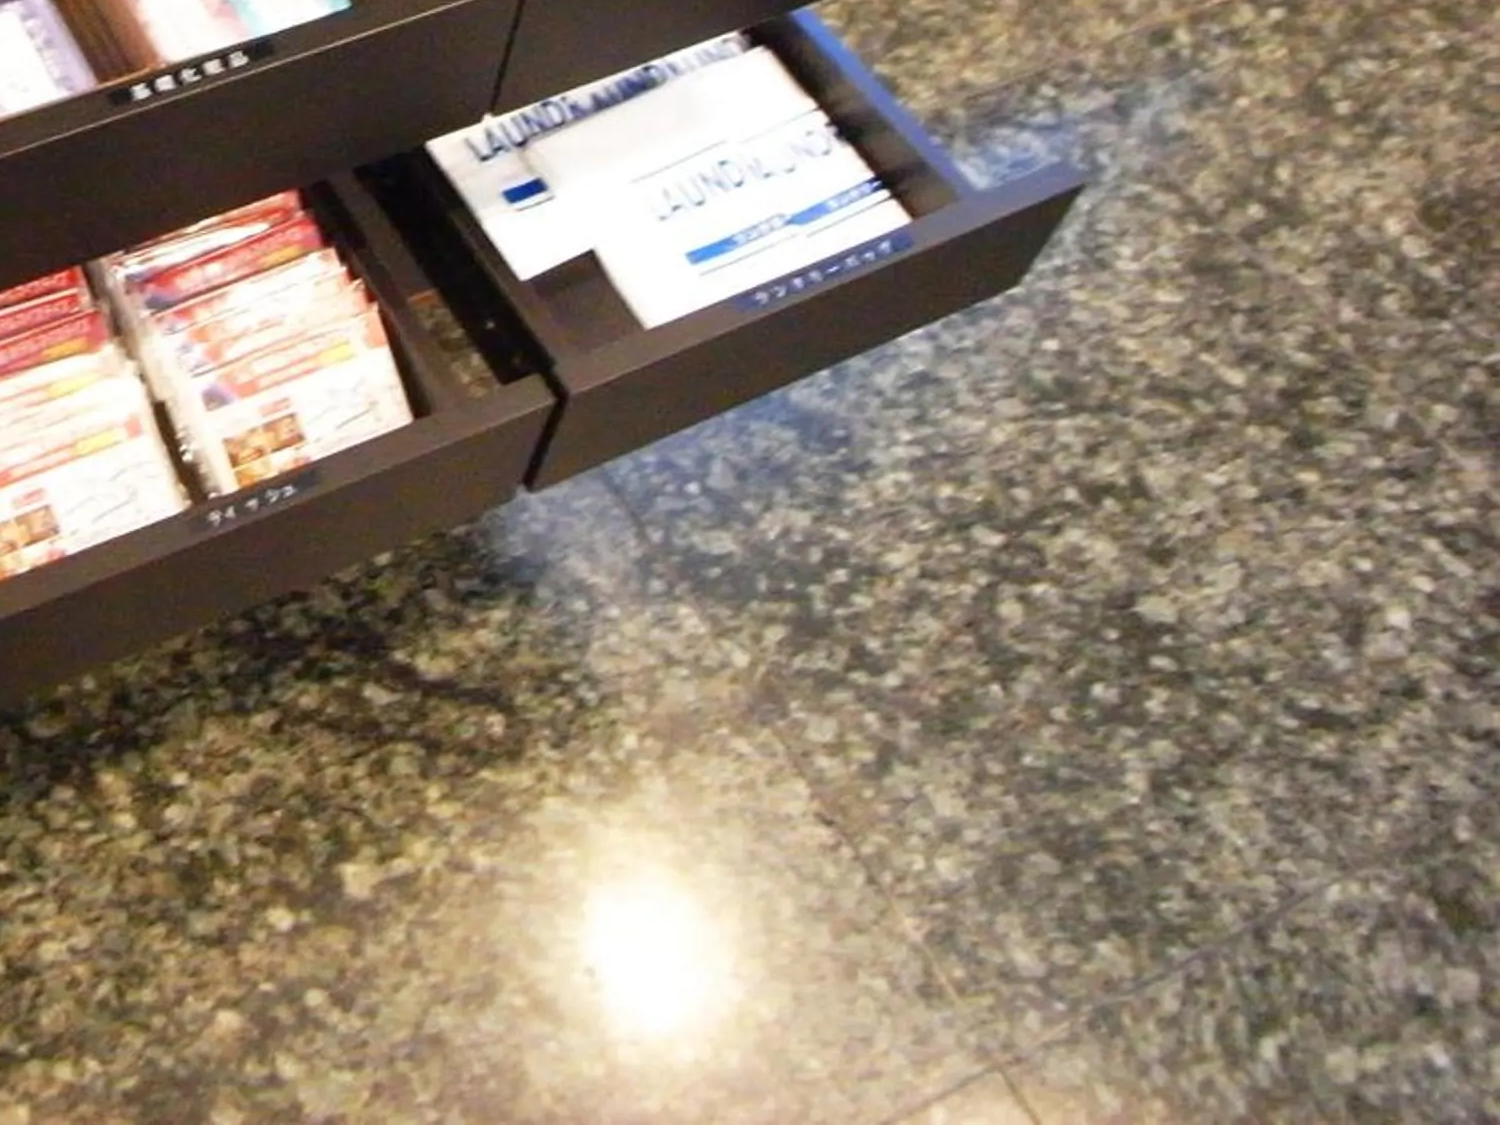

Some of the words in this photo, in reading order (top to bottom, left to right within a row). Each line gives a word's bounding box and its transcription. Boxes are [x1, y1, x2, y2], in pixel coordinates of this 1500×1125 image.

[206, 483, 297, 528] ティッシュ
